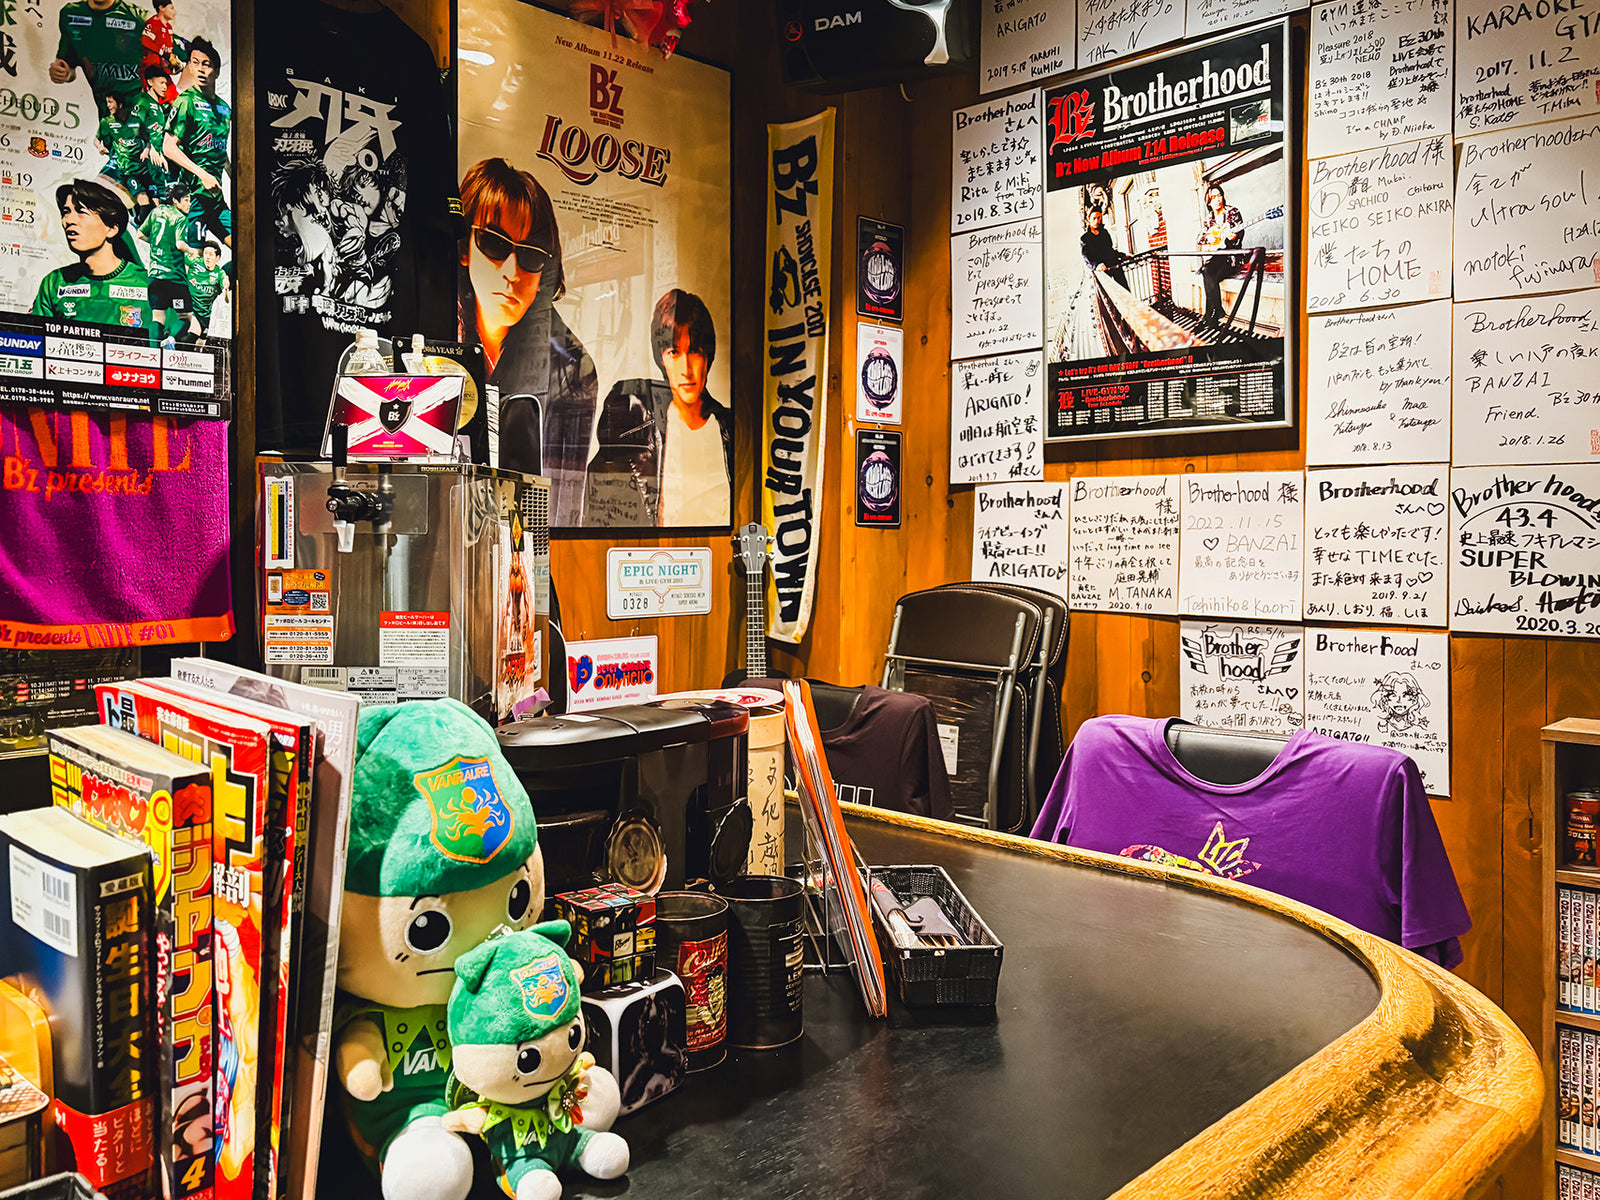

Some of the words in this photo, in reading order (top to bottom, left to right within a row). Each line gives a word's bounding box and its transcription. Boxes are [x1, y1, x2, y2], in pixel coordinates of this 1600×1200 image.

[814, 10, 862, 32] DAM
[997, 12, 1047, 38] ARIGATO
[1317, 40, 1351, 55] Pleasure
[1353, 30, 1374, 44] 2018
[1418, 27, 1445, 43] 30th
[554, 36, 574, 48] New
[574, 41, 601, 57] Album
[602, 50, 625, 64] 11.22
[626, 57, 655, 75] Release
[1558, 46, 1580, 63] 2
[589, 63, 625, 116] B'z
[1102, 43, 1272, 126] Brotherhood
[1329, 75, 1348, 85] 30th
[1351, 71, 1371, 81] 2018
[956, 92, 1036, 131] Brotherhood
[1314, 108, 1338, 118] Shimo
[1004, 115, 1039, 133] さんへ
[64, 145, 83, 160] 20
[535, 113, 671, 188] LOOSE
[1056, 161, 1073, 178] B'z
[1073, 155, 1100, 174] New
[1101, 147, 1141, 168] Album
[1143, 140, 1167, 161] 7.14
[1168, 127, 1226, 154] Release
[1313, 142, 1420, 185] Brotherhood
[16, 173, 33, 187] 19
[773, 135, 819, 226] B'z
[961, 186, 989, 202] Rita
[1006, 172, 1031, 190] Miki
[995, 192, 1015, 202] from
[1016, 183, 1043, 197] Tokyo
[1346, 191, 1389, 211] SACHICO
[15, 208, 35, 224] 23
[1311, 217, 1360, 239] KEIKO
[1368, 206, 1413, 227] SEIKO
[1418, 199, 1453, 218] AKIRA
[1470, 198, 1536, 228] ultra
[968, 223, 1027, 250] Brotherhood
[794, 218, 822, 299] SHOWCASE
[1314, 239, 1412, 269] 僕たちの
[1346, 258, 1422, 290] HOME
[804, 301, 826, 338] 2017
[1464, 303, 1592, 333] Brotherhood
[45, 323, 61, 333] TOP
[63, 325, 101, 338] PARTNER
[768, 322, 807, 377] IN
[122, 371, 156, 384] ナナヨウ
[177, 377, 212, 388] hummel
[1465, 371, 1552, 394] BANZAI
[1547, 391, 1570, 406] B'z
[387, 410, 400, 422] B'z
[1485, 405, 1540, 423] Friend.
[765, 374, 817, 496] YOUR
[45, 468, 154, 501] presents
[1074, 477, 1167, 502] Brotherhood
[1319, 477, 1439, 502] Brotherhood
[979, 488, 1062, 512] Brotherhood
[1394, 503, 1426, 515] さんへ
[1495, 507, 1558, 529] 43.4
[1226, 533, 1297, 553] BANZAI
[773, 487, 813, 623] TOWN
[1459, 549, 1548, 570] SUPER
[624, 565, 654, 577] EPIC
[658, 564, 698, 576] NIGHT
[989, 561, 1056, 578] ARIGATO
[622, 597, 648, 610] 0328
[1126, 586, 1172, 599] TANAKA
[1254, 597, 1296, 616] Kaori
[14, 629, 81, 647] presents
[82, 622, 136, 648] UNITE
[139, 624, 176, 640] #01
[1204, 633, 1264, 656] Brother
[1221, 656, 1263, 679] hood
[427, 766, 491, 792] VANRAURE
[180, 1155, 206, 1191] 4
